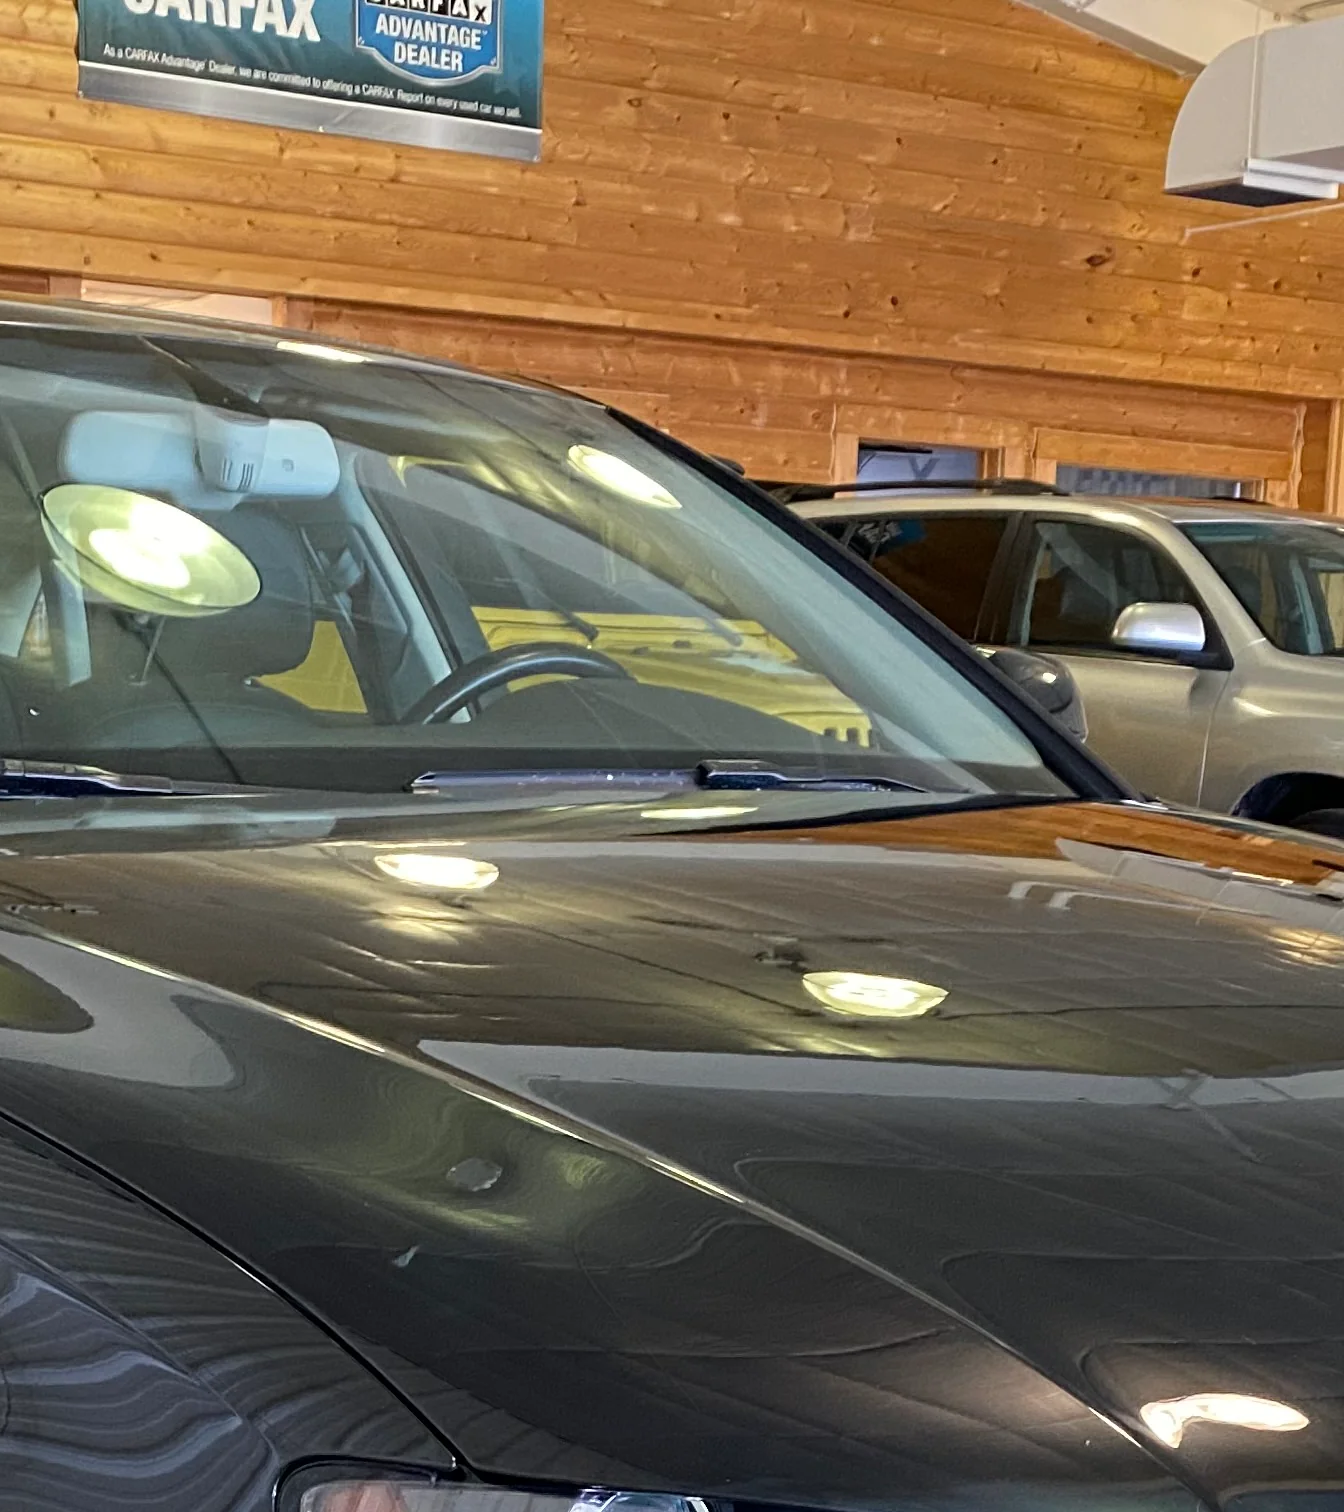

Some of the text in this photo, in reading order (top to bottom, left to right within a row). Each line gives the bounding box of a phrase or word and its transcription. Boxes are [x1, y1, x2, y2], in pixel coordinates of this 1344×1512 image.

[123, 0, 320, 42] FAX
[368, 0, 486, 22] RFAX
[375, 13, 482, 50] ADVANTAGE
[394, 42, 463, 72] DEALER
[103, 43, 115, 57] As
[117, 48, 123, 58] a
[125, 47, 159, 62] CARFAX
[239, 66, 252, 78] we
[253, 68, 267, 80] are
[268, 71, 311, 86] committed
[312, 77, 321, 89] to
[322, 79, 353, 96] offering
[362, 84, 394, 99] CARFAX
[397, 89, 424, 104] Report
[425, 94, 435, 105] on
[436, 97, 458, 110] every
[459, 101, 478, 112] used
[480, 104, 492, 114] car
[494, 106, 505, 116] we
